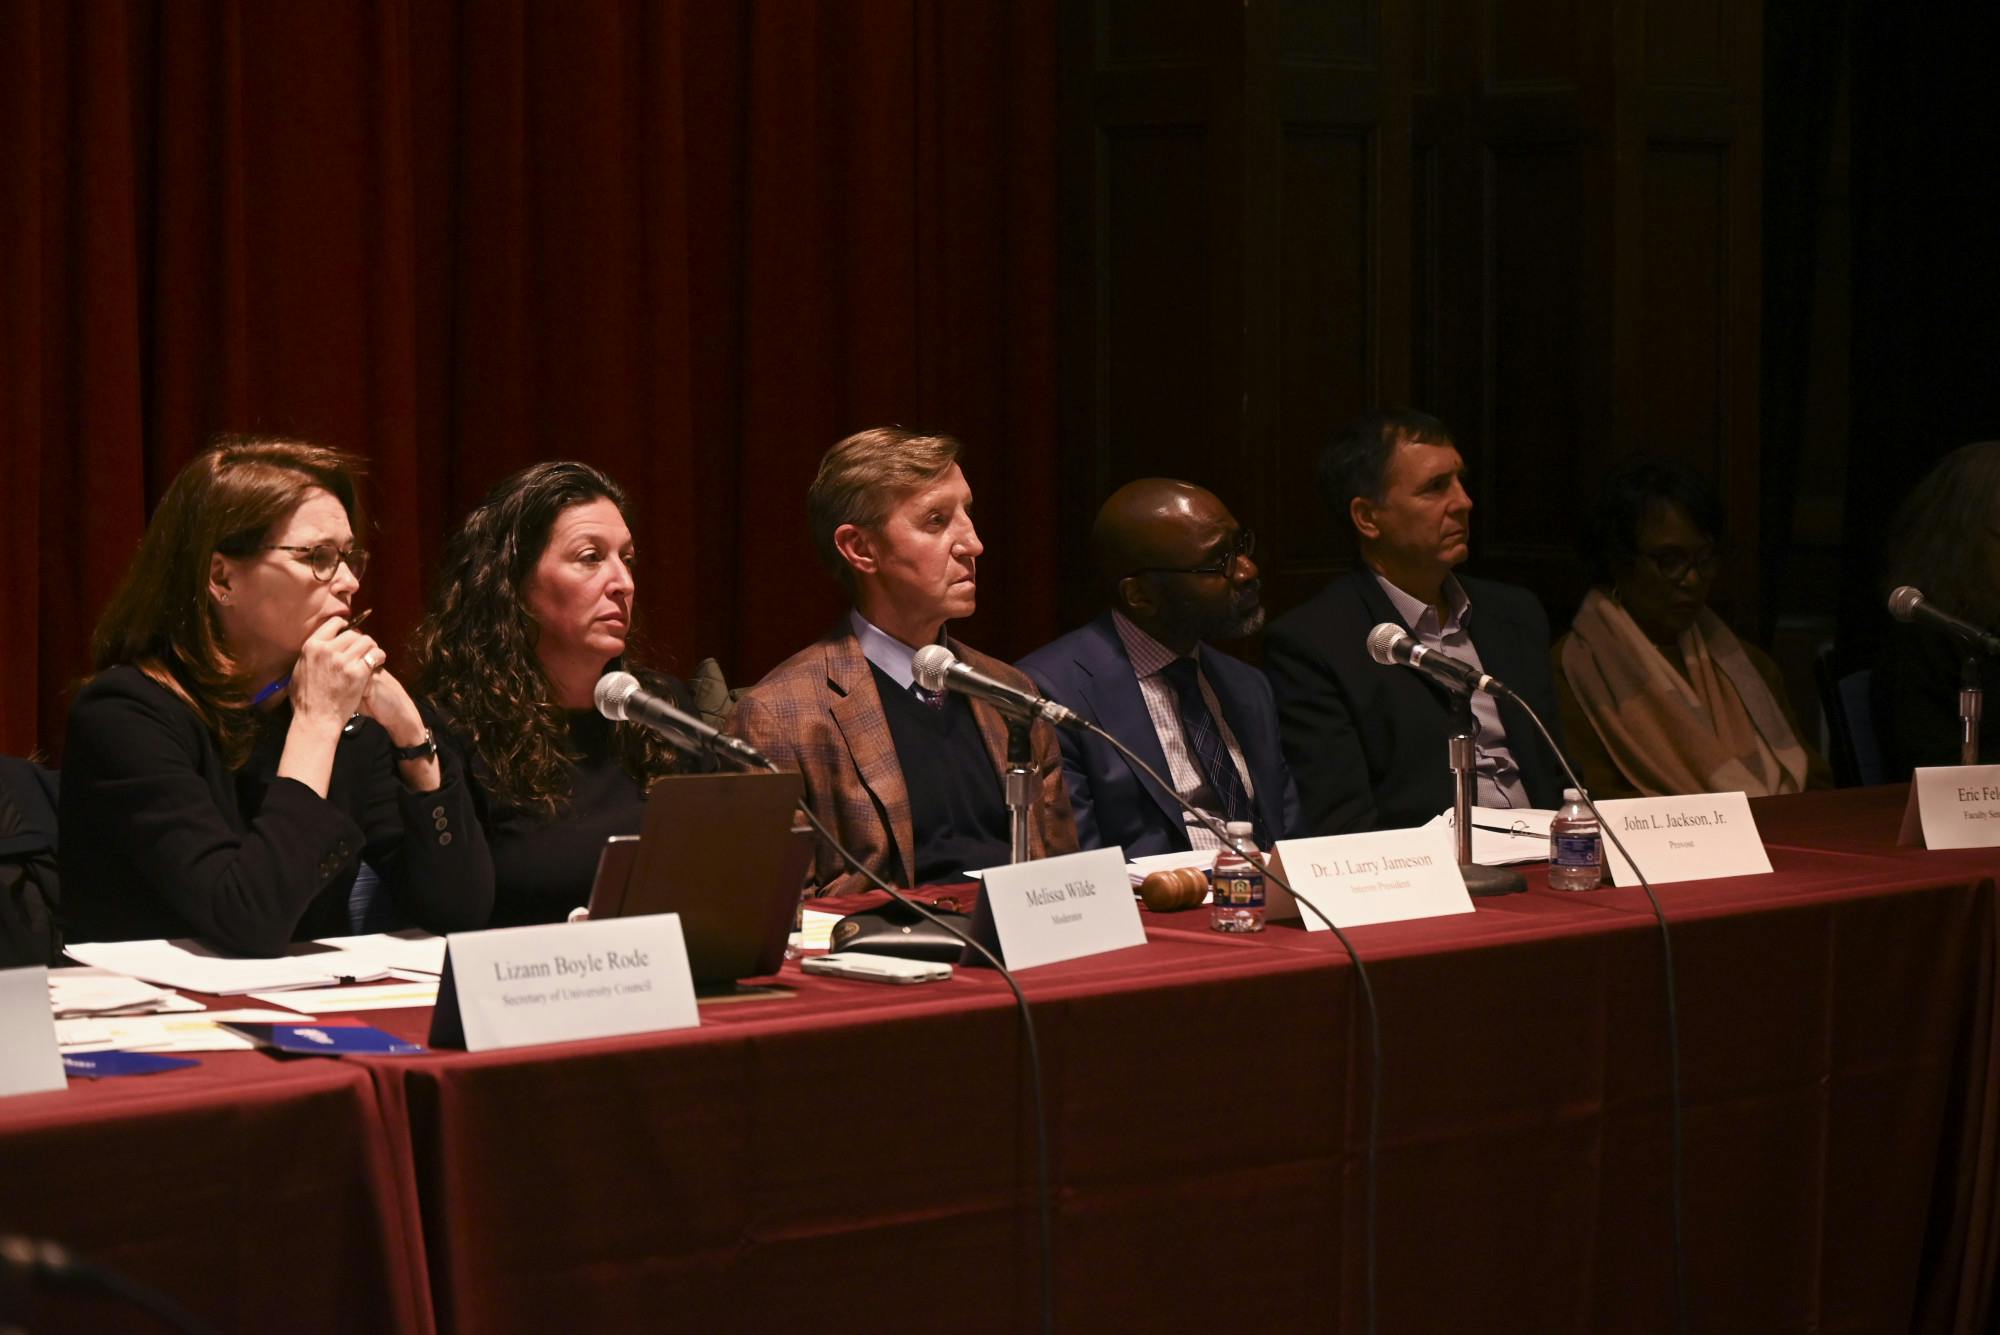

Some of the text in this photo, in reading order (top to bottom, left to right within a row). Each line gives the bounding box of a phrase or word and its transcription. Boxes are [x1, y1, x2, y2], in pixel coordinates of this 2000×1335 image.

[1958, 786, 1979, 802] Eric
[1623, 810, 1728, 831] John L. Jackson, Jr.
[1311, 854, 1433, 878] Dr. J. Larry Jameson
[1025, 880, 1096, 907] Melissa Wilde
[494, 949, 649, 982] Lizann Boyle Rode
[502, 979, 653, 1006] Secretary of University Council
